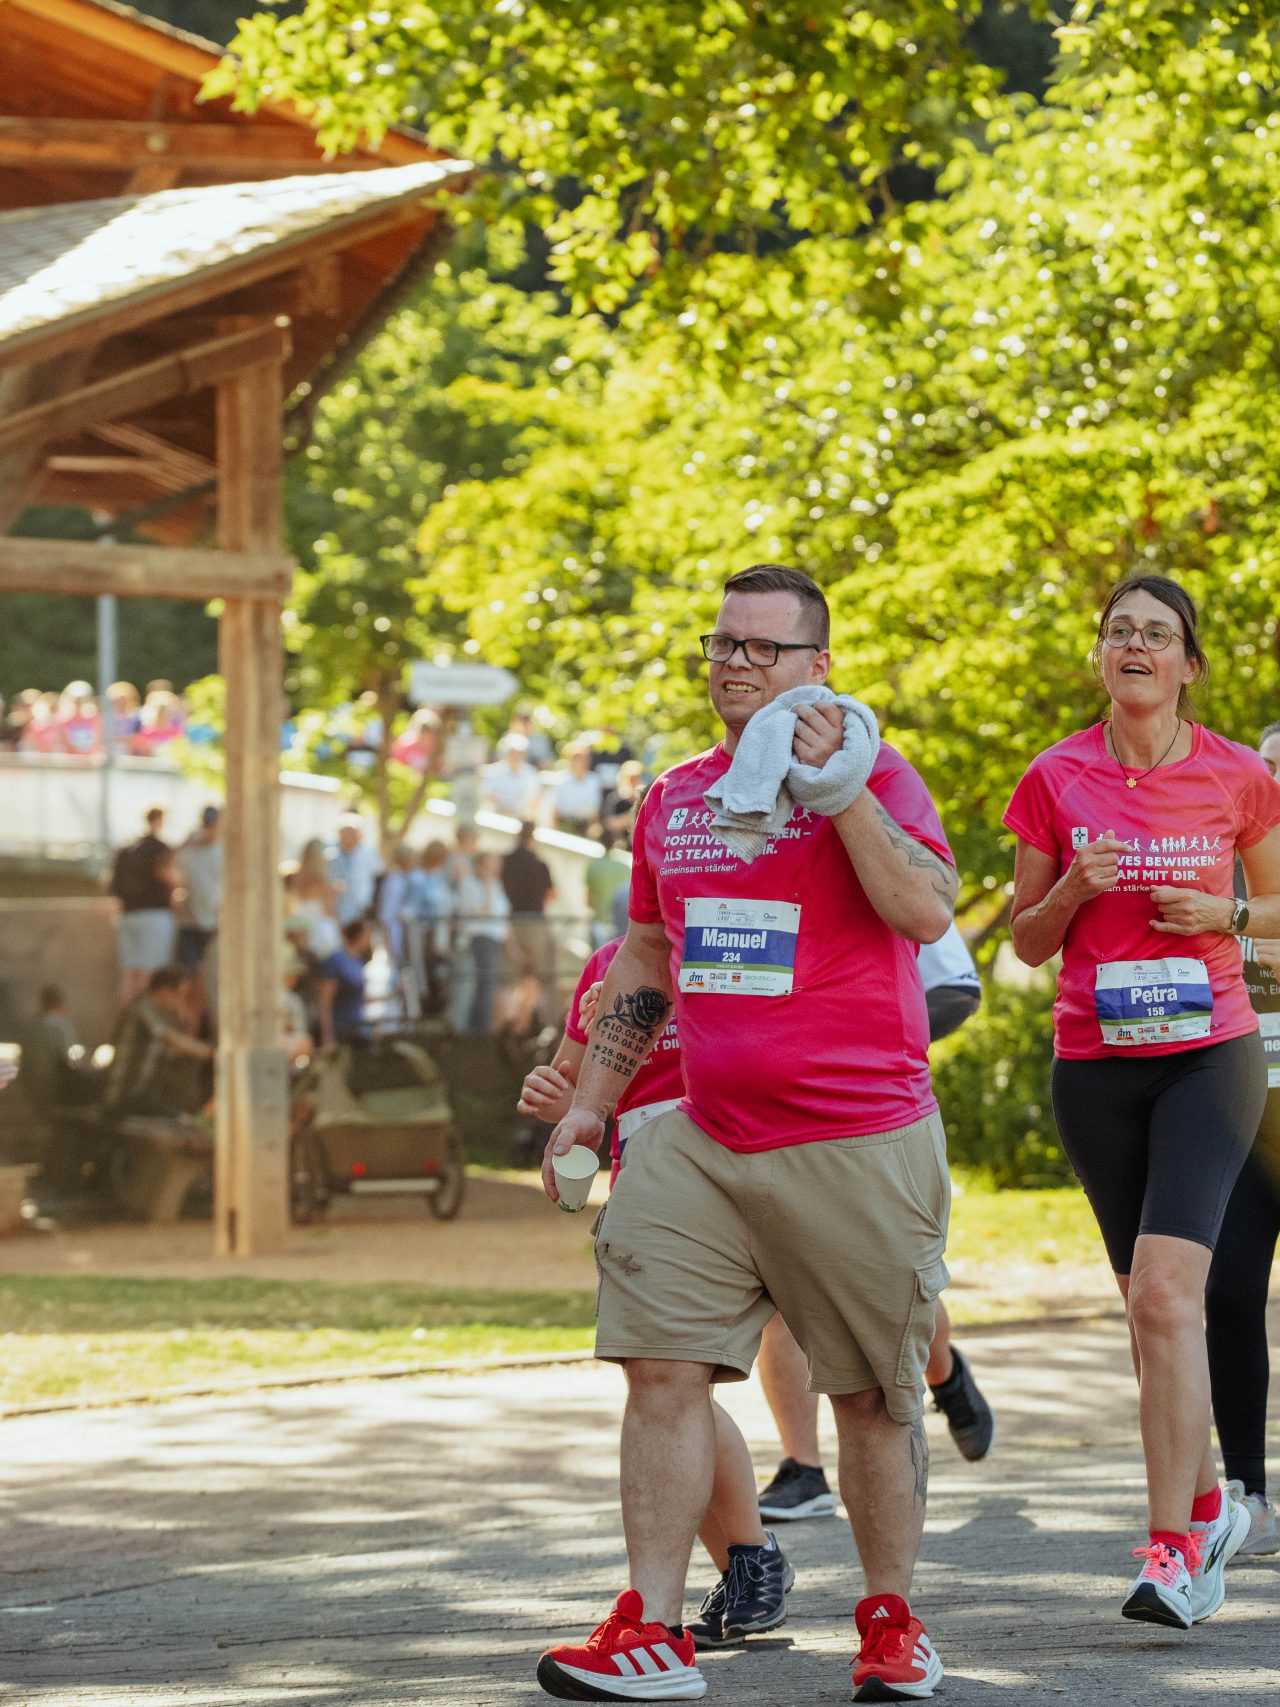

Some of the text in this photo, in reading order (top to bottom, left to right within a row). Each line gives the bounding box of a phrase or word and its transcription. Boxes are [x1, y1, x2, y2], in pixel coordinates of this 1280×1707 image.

[664, 834, 724, 847] POSITIVE
[664, 851, 682, 862] ALS
[685, 848, 724, 860] TEAM
[762, 843, 778, 855] IR.
[660, 863, 737, 875] Gemeinsam stärker!
[1116, 869, 1200, 881] AM MIT DIR.
[1123, 884, 1150, 892] stärke
[701, 928, 768, 949] Manuel
[722, 952, 740, 962] 234
[689, 972, 703, 982] dm
[1130, 986, 1178, 1004] Petra
[1246, 984, 1266, 996] eam,
[1147, 1007, 1165, 1017] 158
[1117, 1028, 1131, 1037] dm
[607, 1033, 643, 1054] 10.05.19
